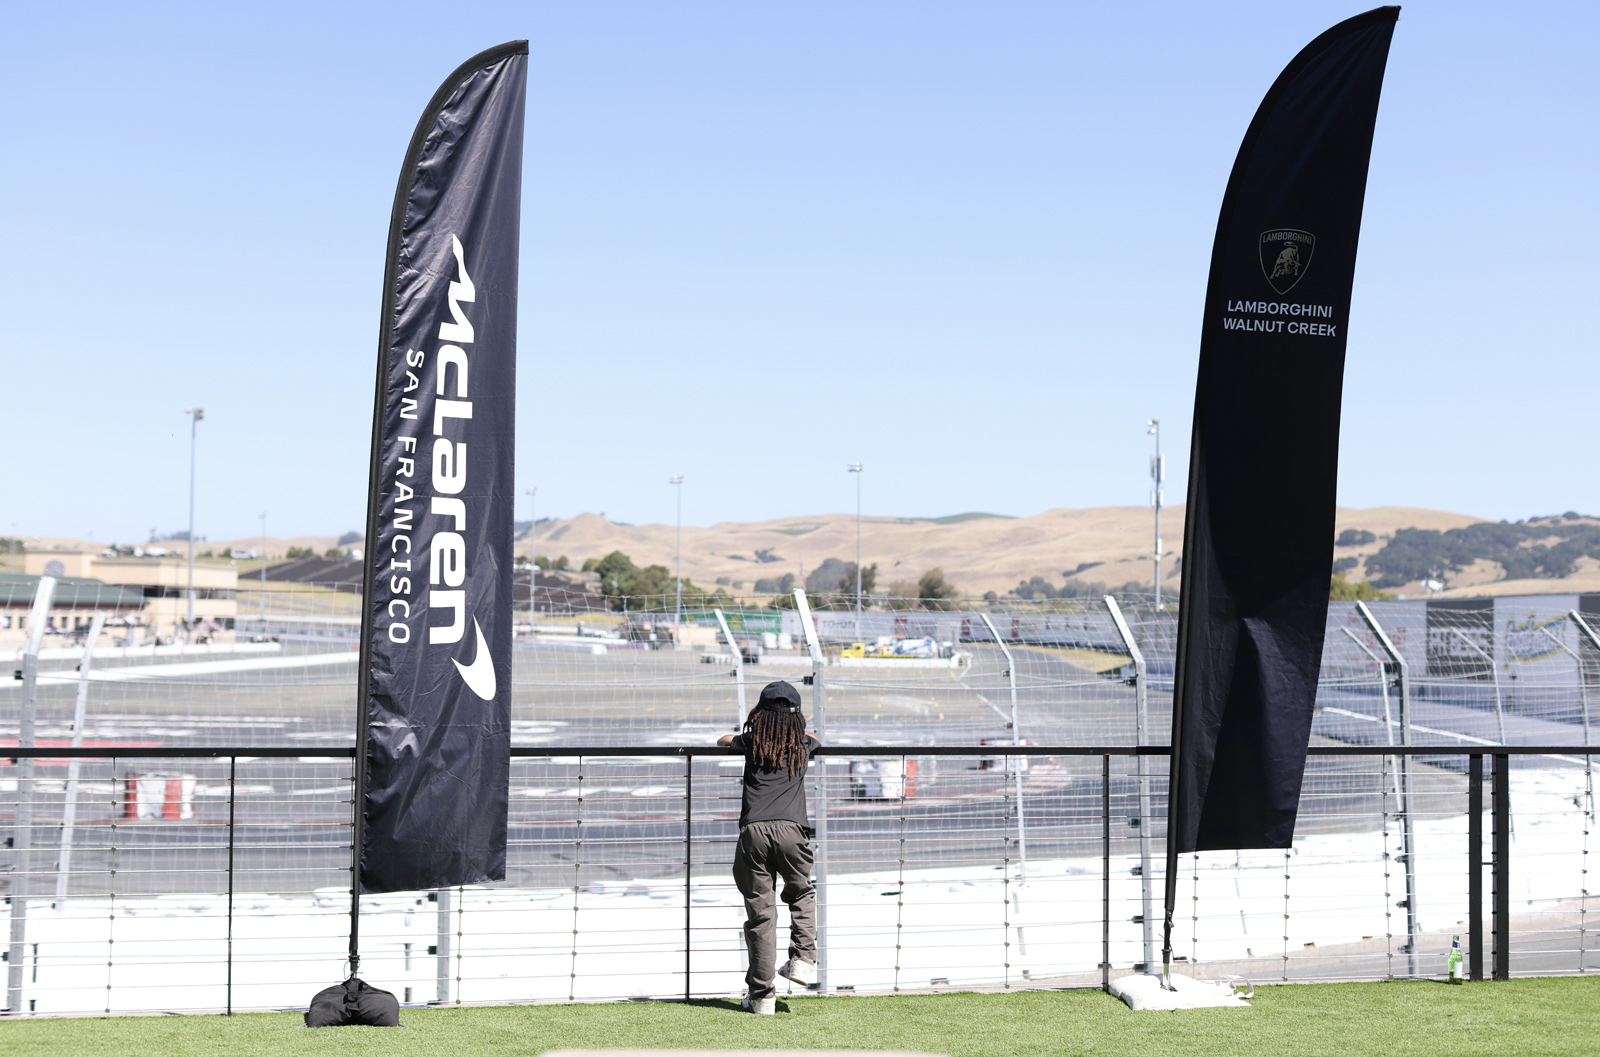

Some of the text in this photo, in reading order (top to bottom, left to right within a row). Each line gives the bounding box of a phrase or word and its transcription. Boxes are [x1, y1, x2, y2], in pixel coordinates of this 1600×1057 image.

[1262, 231, 1312, 245] LAMBORGHINI
[1227, 300, 1333, 318] LAMBORGHINI
[1223, 318, 1337, 337] WALNUT CREEK
[429, 233, 476, 645] McLaren
[388, 348, 425, 644] SAN FRANCISCO
